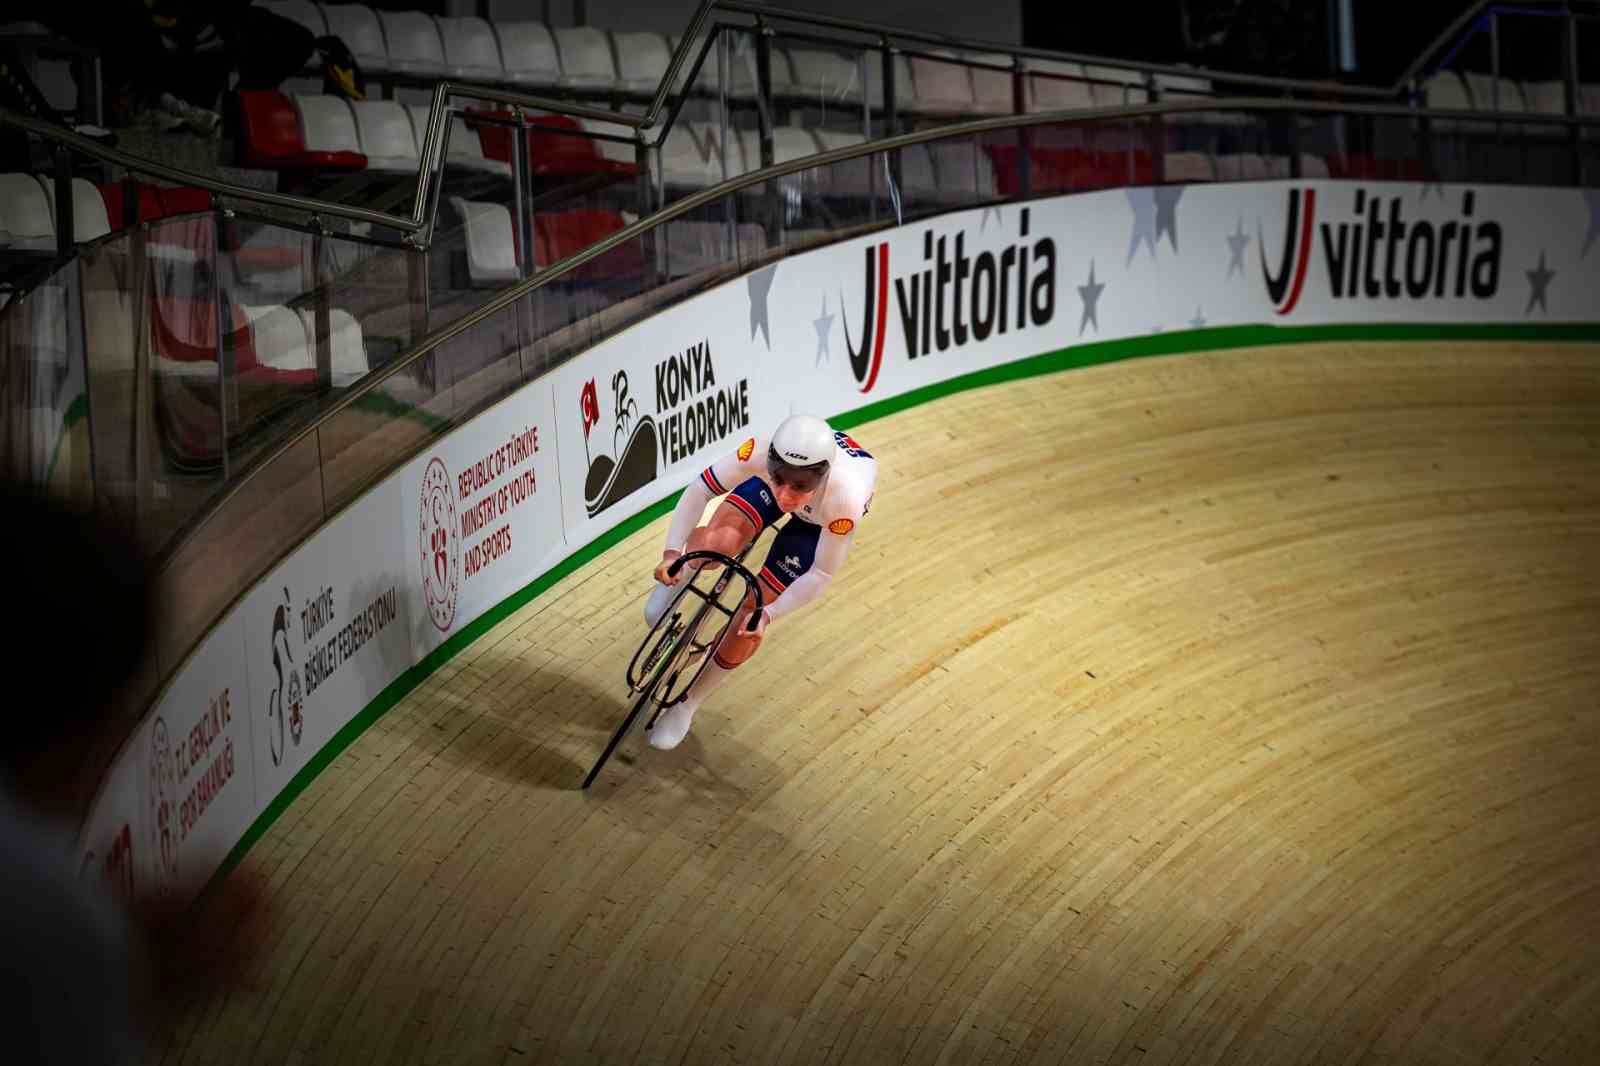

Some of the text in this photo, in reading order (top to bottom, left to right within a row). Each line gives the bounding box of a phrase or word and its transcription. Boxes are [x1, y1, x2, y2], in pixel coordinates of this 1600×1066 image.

[1322, 187, 1502, 300] vittoria
[895, 207, 1057, 360] vittoria
[655, 337, 715, 413] KONYA
[457, 424, 539, 501] REPUBLIC OF TÜRKİYE
[658, 378, 749, 472] VELODROME
[784, 451, 809, 461] LAZER
[461, 467, 537, 540] MINISTRY OF YOUTH
[463, 524, 512, 580] AND SPORTS
[775, 559, 801, 580] LLOYD
